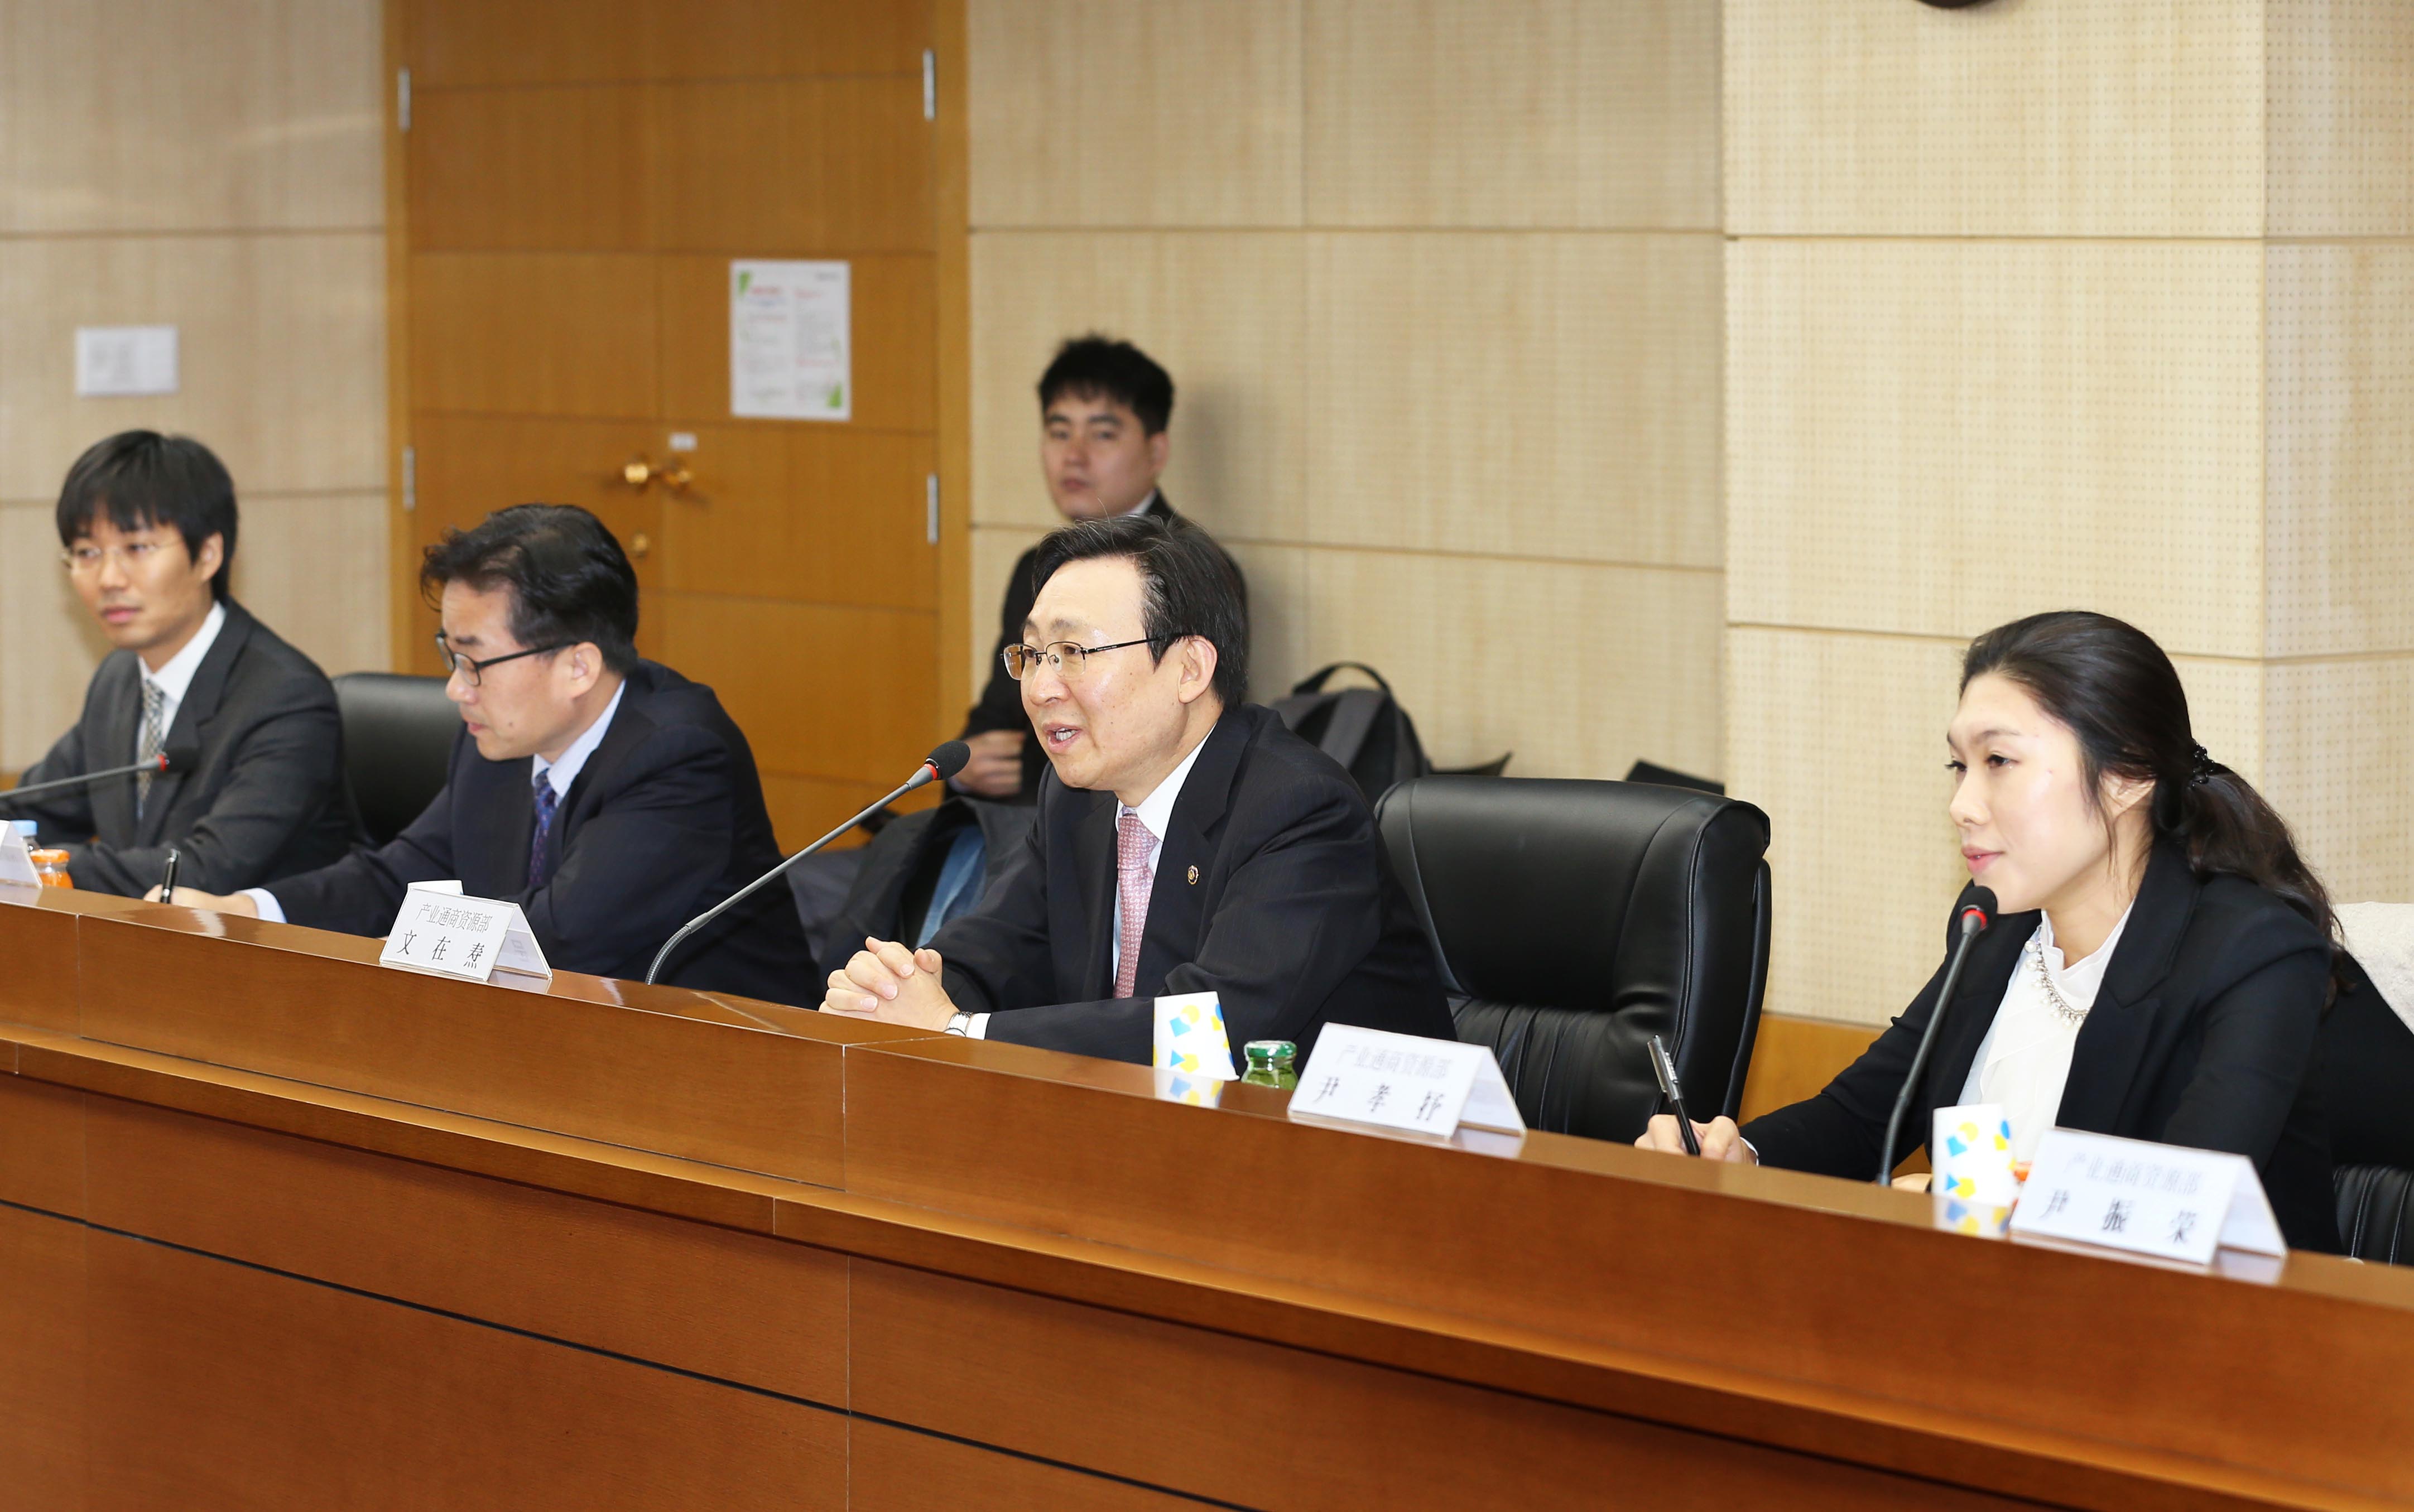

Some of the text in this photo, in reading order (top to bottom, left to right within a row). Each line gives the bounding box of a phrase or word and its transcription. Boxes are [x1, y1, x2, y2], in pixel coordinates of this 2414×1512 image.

[415, 902, 494, 934] 产业通商资源部
